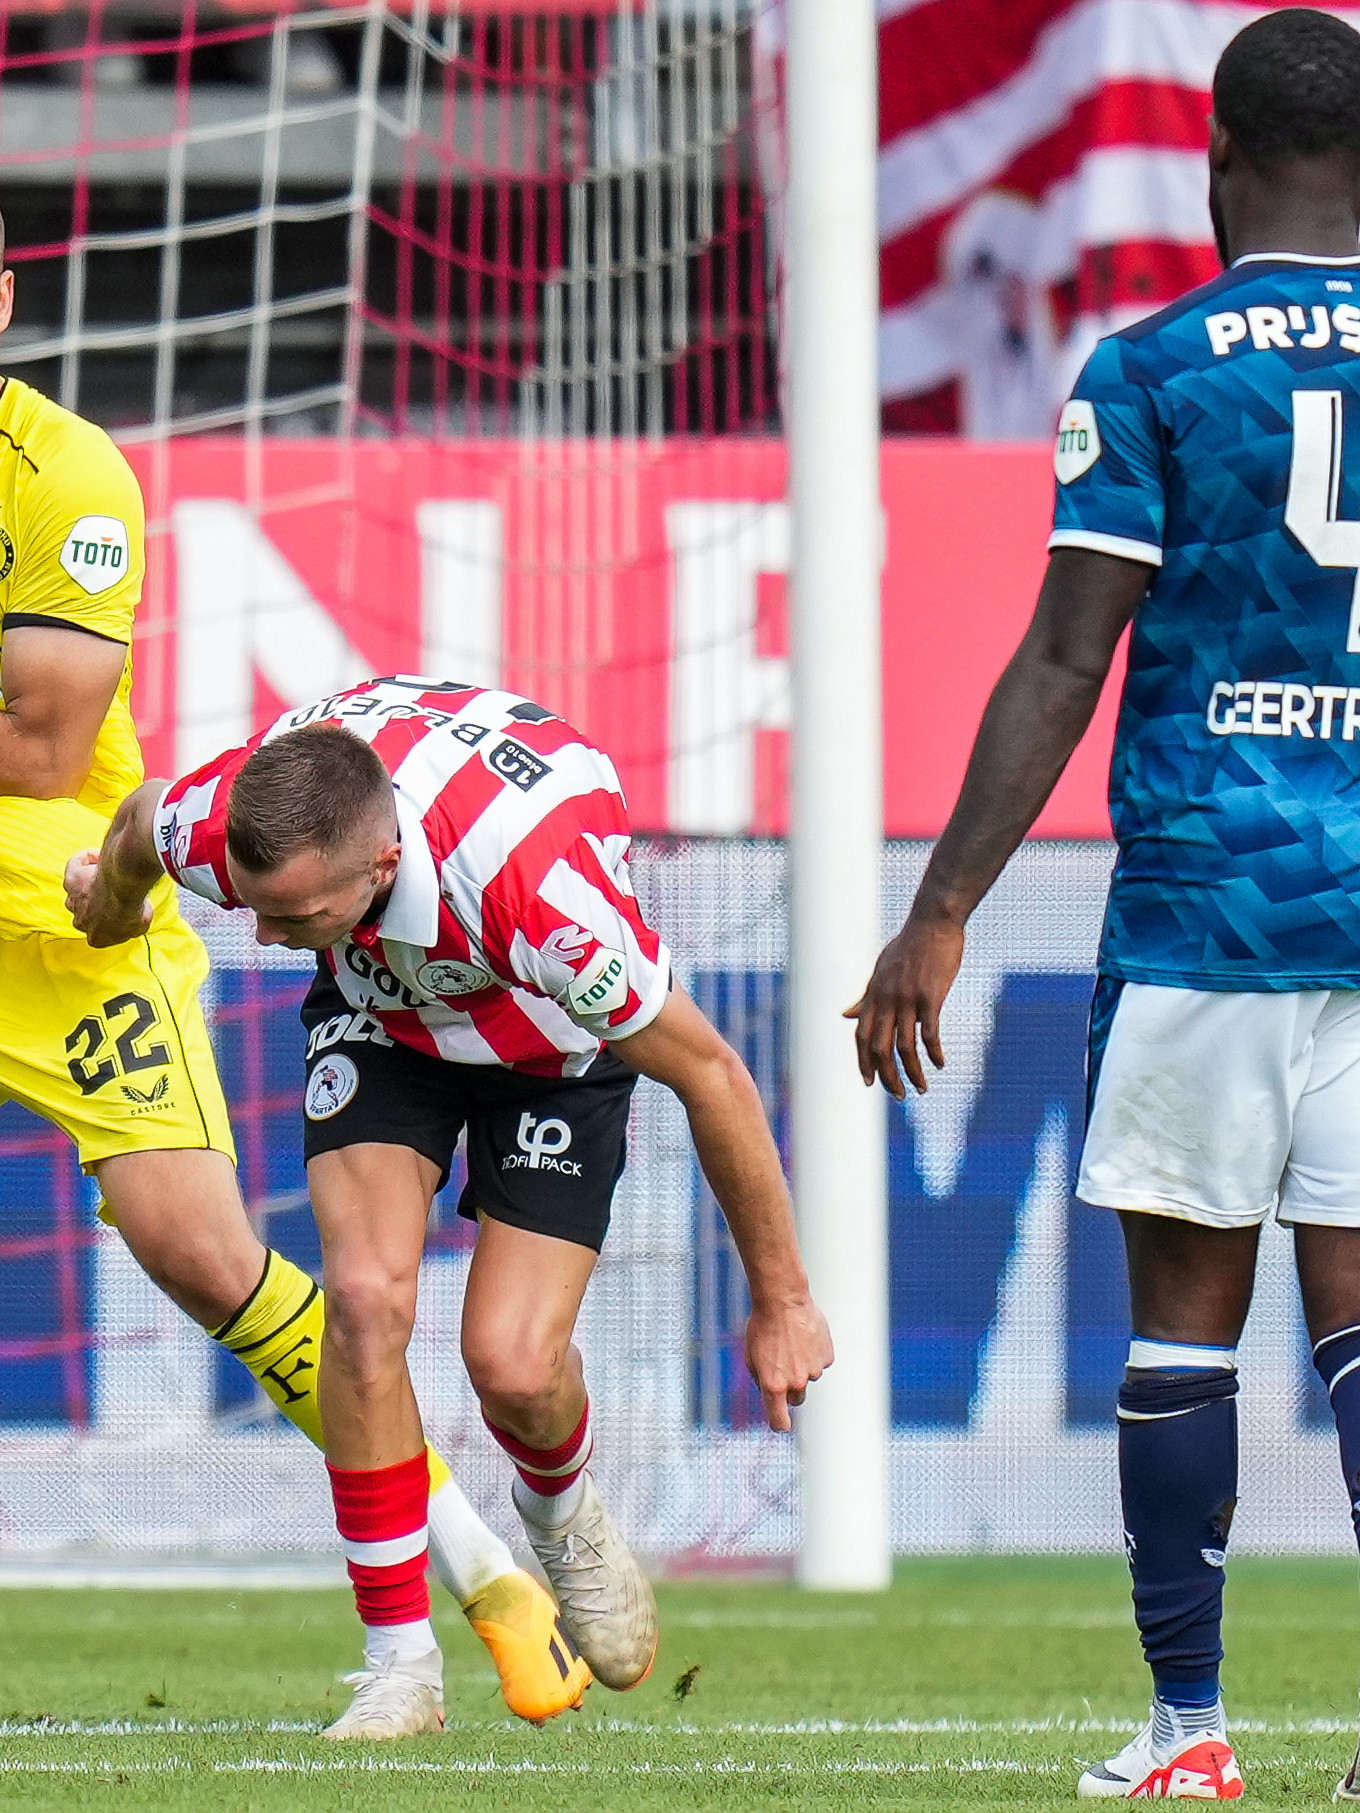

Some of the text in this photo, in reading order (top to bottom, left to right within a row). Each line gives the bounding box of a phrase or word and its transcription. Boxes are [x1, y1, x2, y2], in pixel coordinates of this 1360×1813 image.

[71, 539, 123, 568] TOTO
[575, 957, 623, 1008] TOTO
[64, 990, 174, 1096] 22
[540, 1156, 583, 1177] PACK
